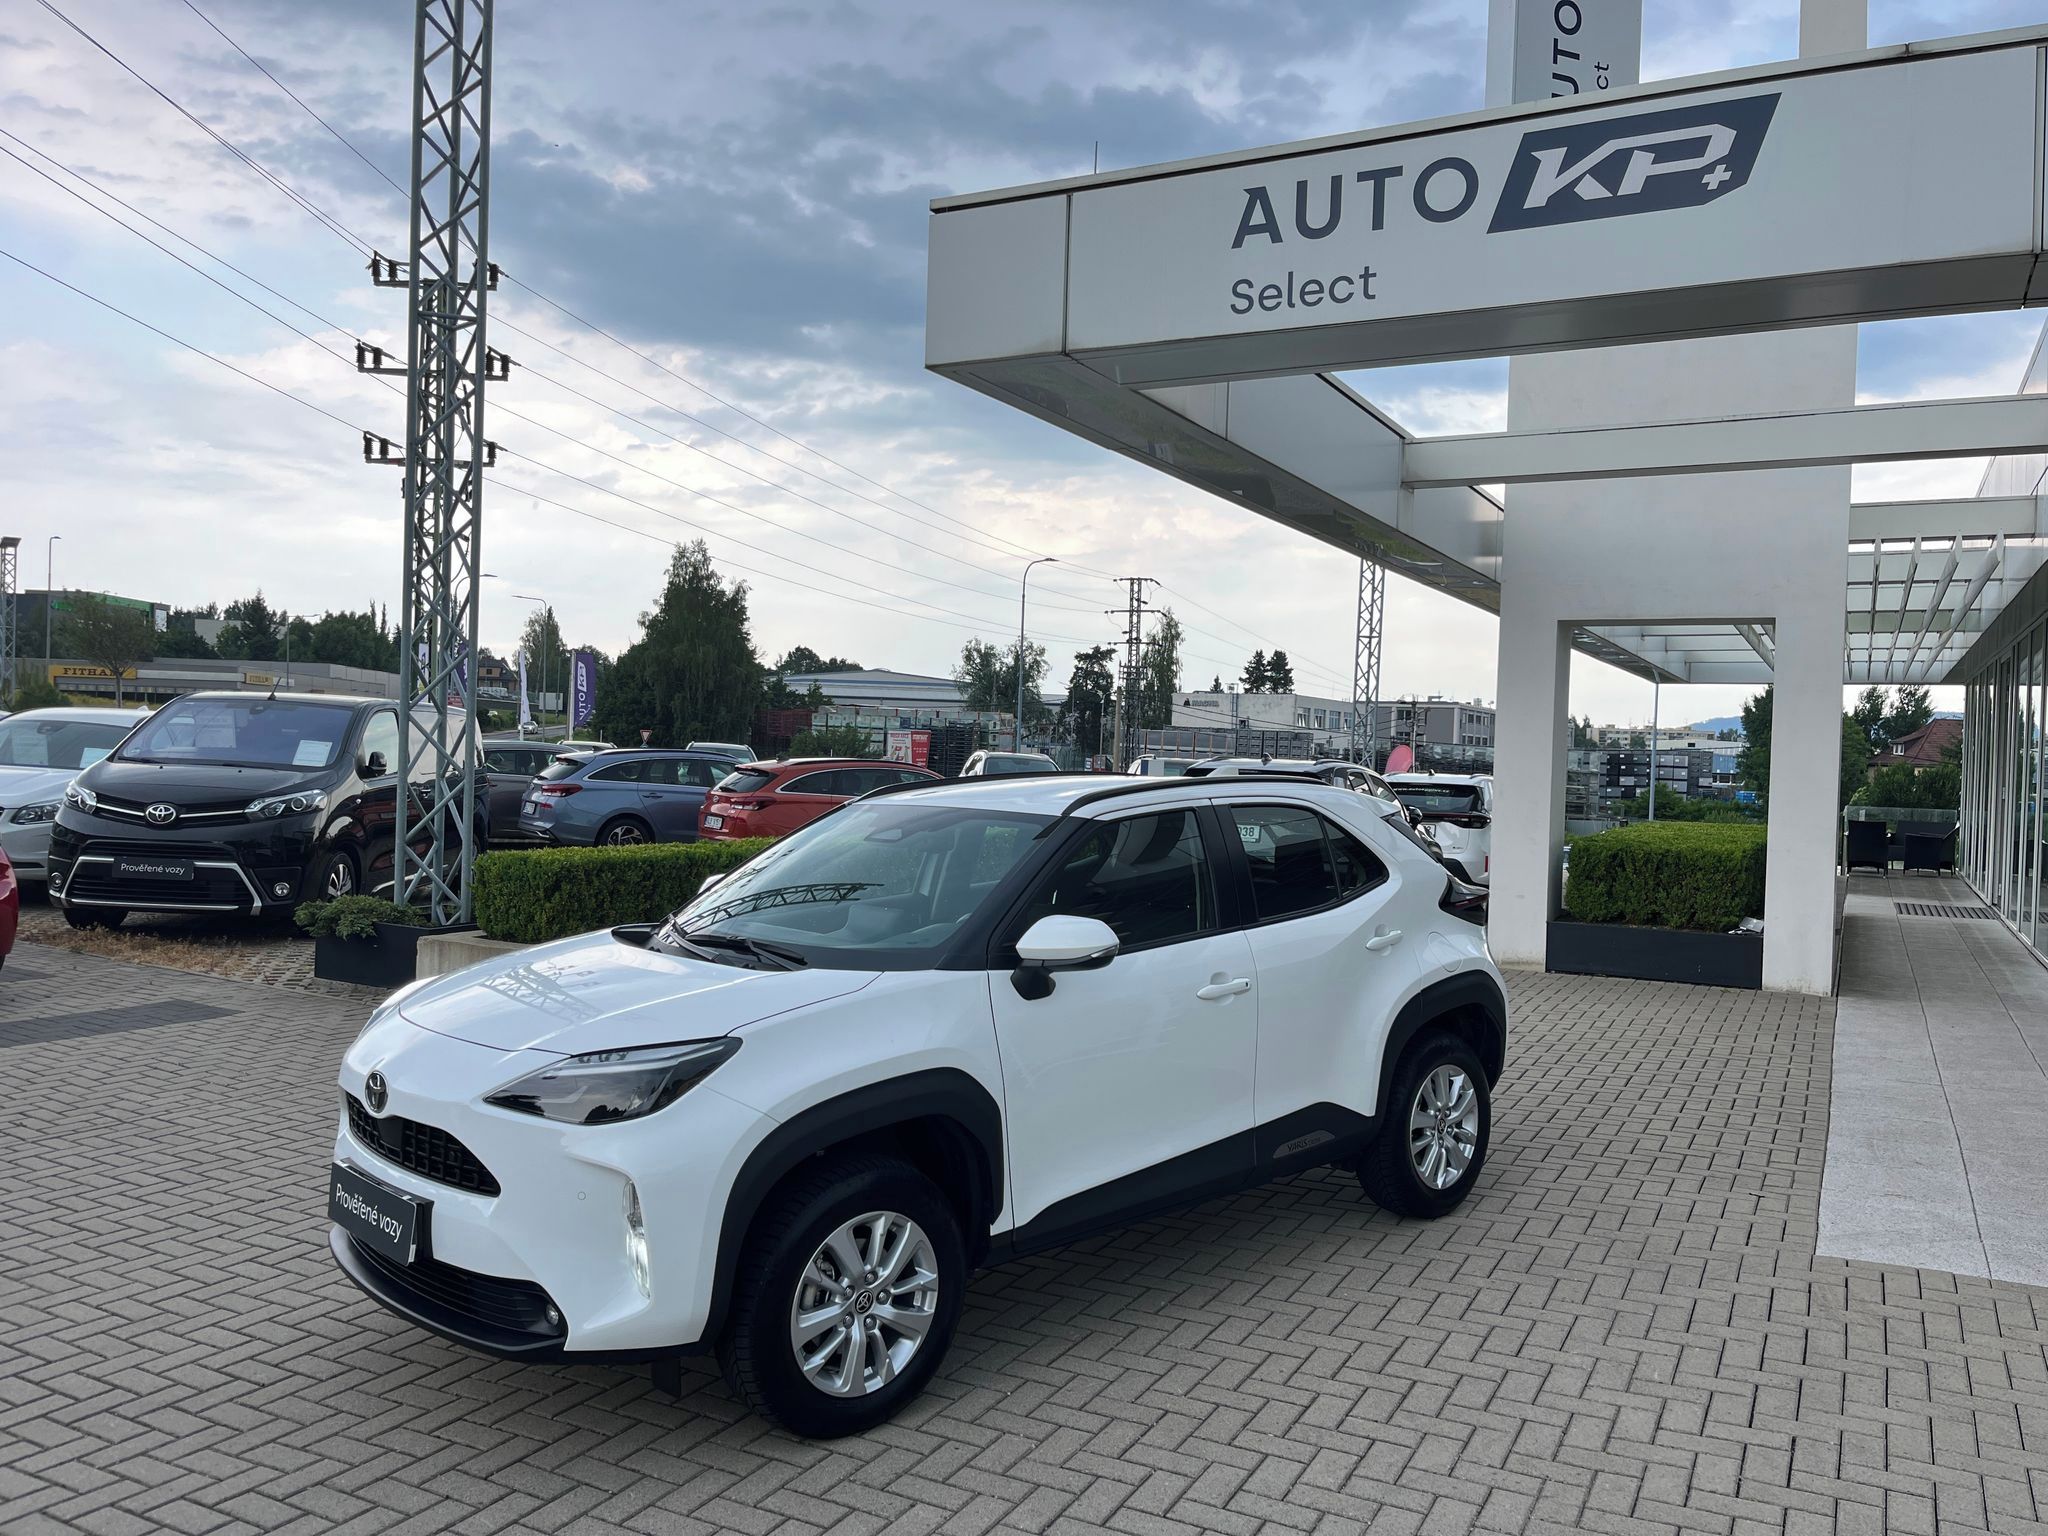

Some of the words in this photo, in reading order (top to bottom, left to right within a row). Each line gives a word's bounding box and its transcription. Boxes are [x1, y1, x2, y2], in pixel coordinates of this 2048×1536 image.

[1231, 156, 1480, 250] AUTO
[1230, 266, 1377, 315] Select
[63, 667, 117, 677] FITHA
[121, 863, 163, 873] Prověřené
[165, 867, 185, 876] vozy
[335, 1183, 378, 1226] Prověřené
[379, 1213, 403, 1243] vozy
